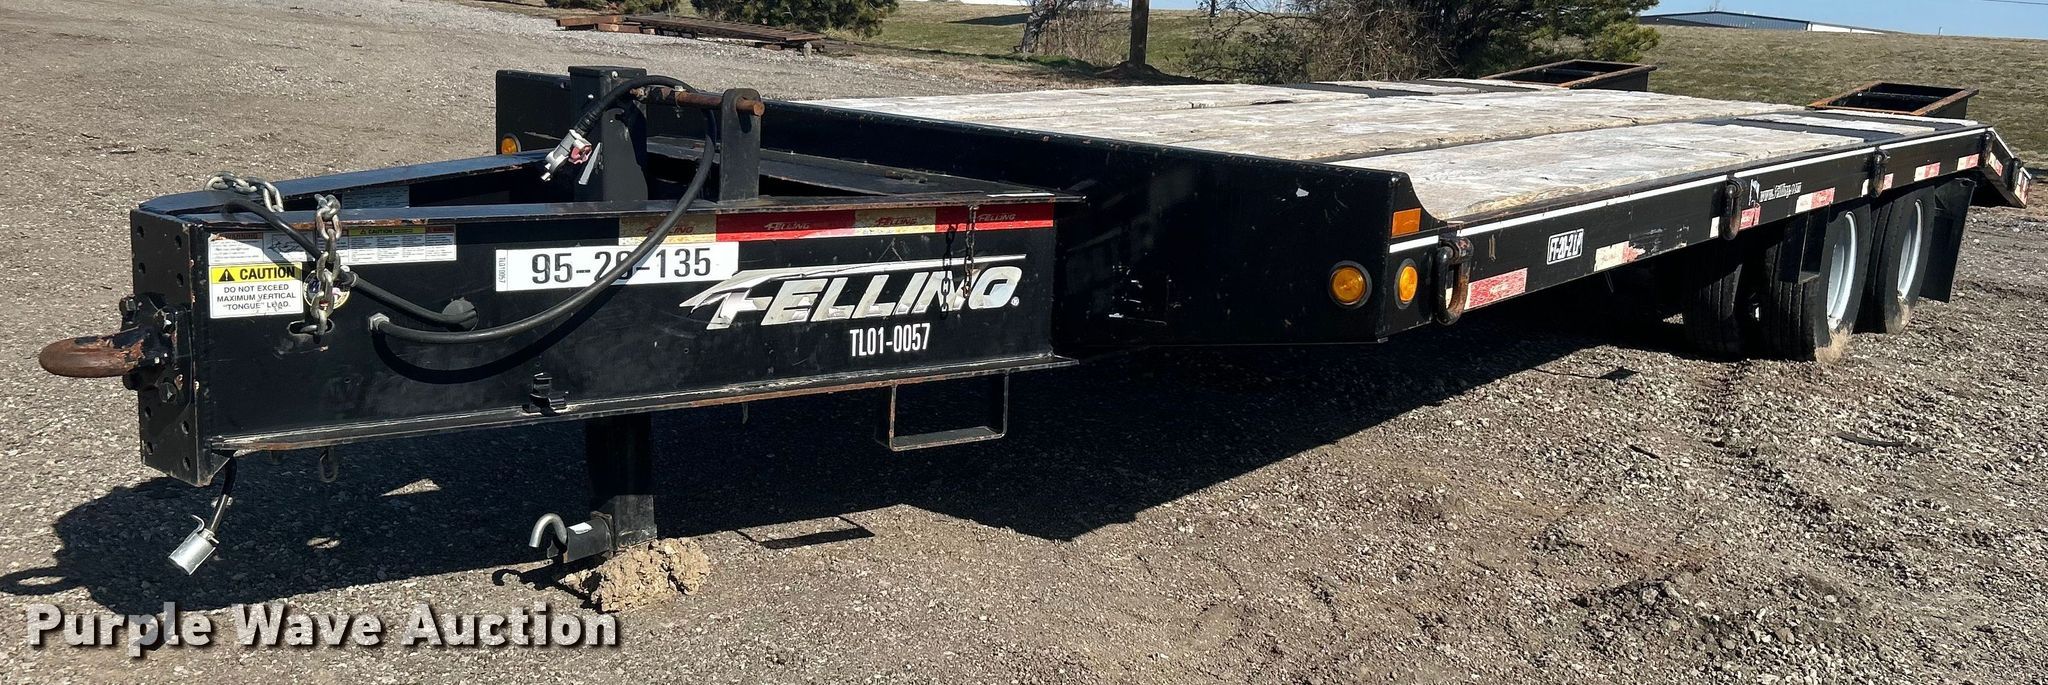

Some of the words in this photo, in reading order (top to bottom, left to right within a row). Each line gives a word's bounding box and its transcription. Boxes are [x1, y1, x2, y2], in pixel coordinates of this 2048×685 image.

[239, 266, 295, 280] CAUTION
[238, 285, 255, 293] NOT
[257, 283, 289, 291] EXCEED
[680, 255, 1021, 330] FELLING
[216, 294, 256, 303] MAXIMUM
[257, 292, 296, 301] VERTICAL
[849, 322, 931, 357] TL01-0057
